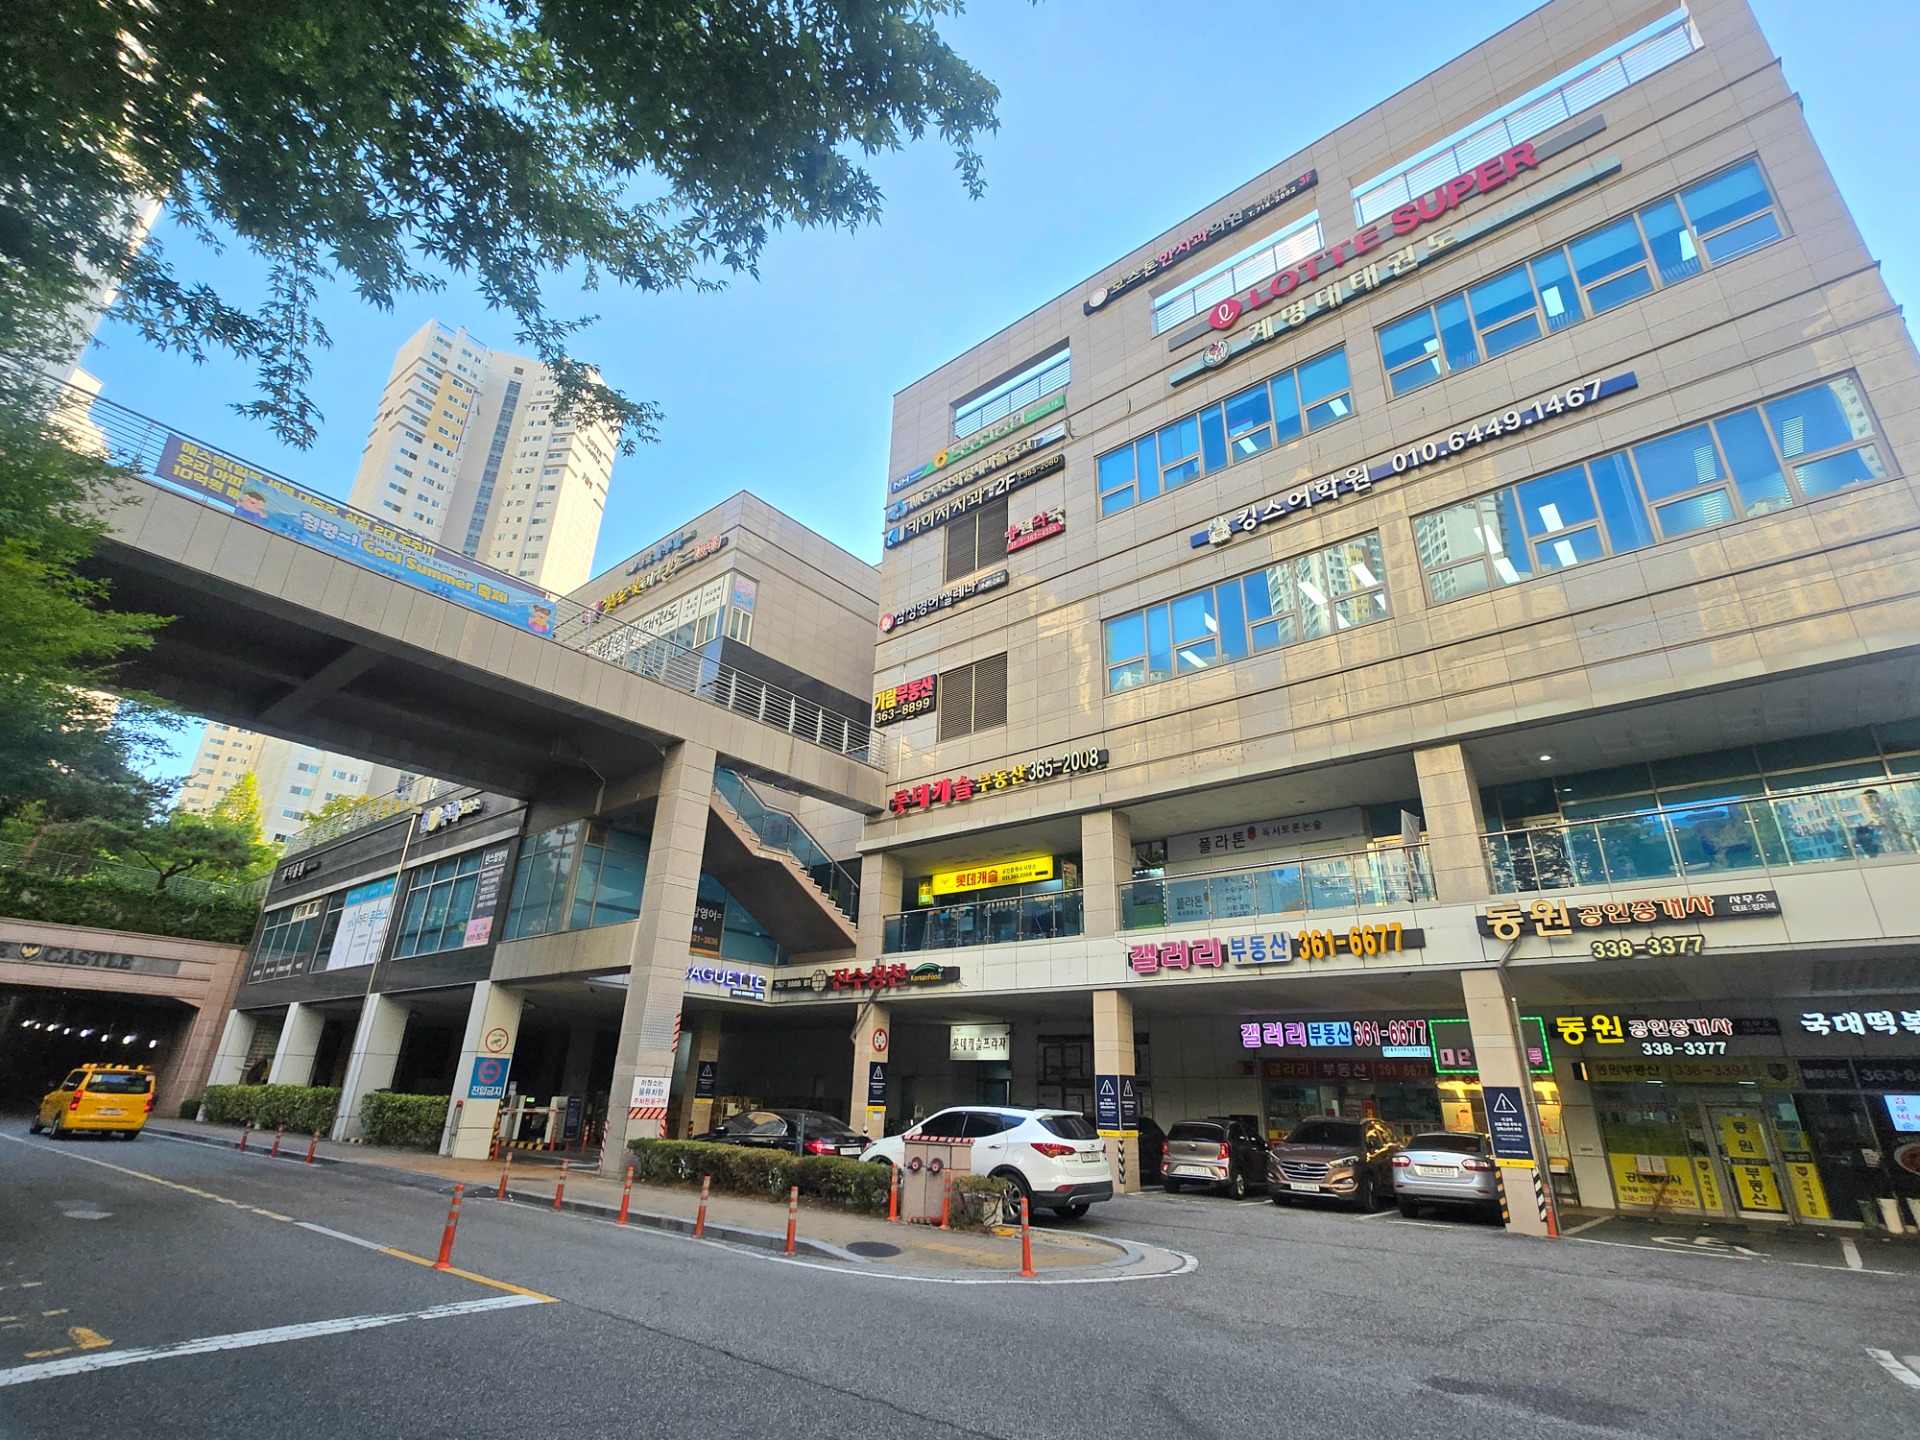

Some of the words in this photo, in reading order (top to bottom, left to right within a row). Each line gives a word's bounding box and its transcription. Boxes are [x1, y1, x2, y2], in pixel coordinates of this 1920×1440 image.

[1299, 172, 1312, 186] 3F
[1250, 226, 1378, 308] LOTTE
[1391, 143, 1539, 235] SUPER
[177, 452, 210, 473] 우리
[1237, 463, 1372, 531] 킹스어학원
[1392, 379, 1602, 473] 010.6449.1467
[893, 476, 909, 490] NH
[906, 487, 984, 533] 카이저치과
[362, 539, 403, 565] Cool
[405, 556, 475, 591] Summer
[875, 698, 930, 723] 363-8899
[891, 775, 974, 815] 롯데캐슬
[976, 764, 1027, 792] 부동산
[1028, 747, 1099, 781] 365-2008
[1198, 831, 1247, 854] 플라톤
[956, 869, 999, 888] 롯데캐슬
[1176, 894, 1204, 911] 플라톤
[1486, 899, 1573, 941] 동원
[1578, 894, 1715, 926] 공인중개사
[44, 948, 135, 970] CASTLE
[1130, 937, 1222, 974] 갤러리
[1229, 933, 1290, 963] 부동산
[1297, 922, 1403, 961] 361-6677
[1591, 936, 1705, 960] 338-3377
[832, 963, 908, 992] 진수성찬
[1241, 1021, 1307, 1047] 갤러리
[1309, 1023, 1351, 1046] 부동산
[1353, 1019, 1427, 1046] 361-6677
[1556, 1014, 1625, 1046] 동원
[1628, 1018, 1734, 1038] 공인중개사
[1641, 1041, 1728, 1056] 338-3377
[1269, 1061, 1309, 1076] 갤러리
[1322, 1060, 1367, 1077] 부동산
[471, 1085, 503, 1096] 진입금지
[1744, 1166, 1769, 1207] 부동산
